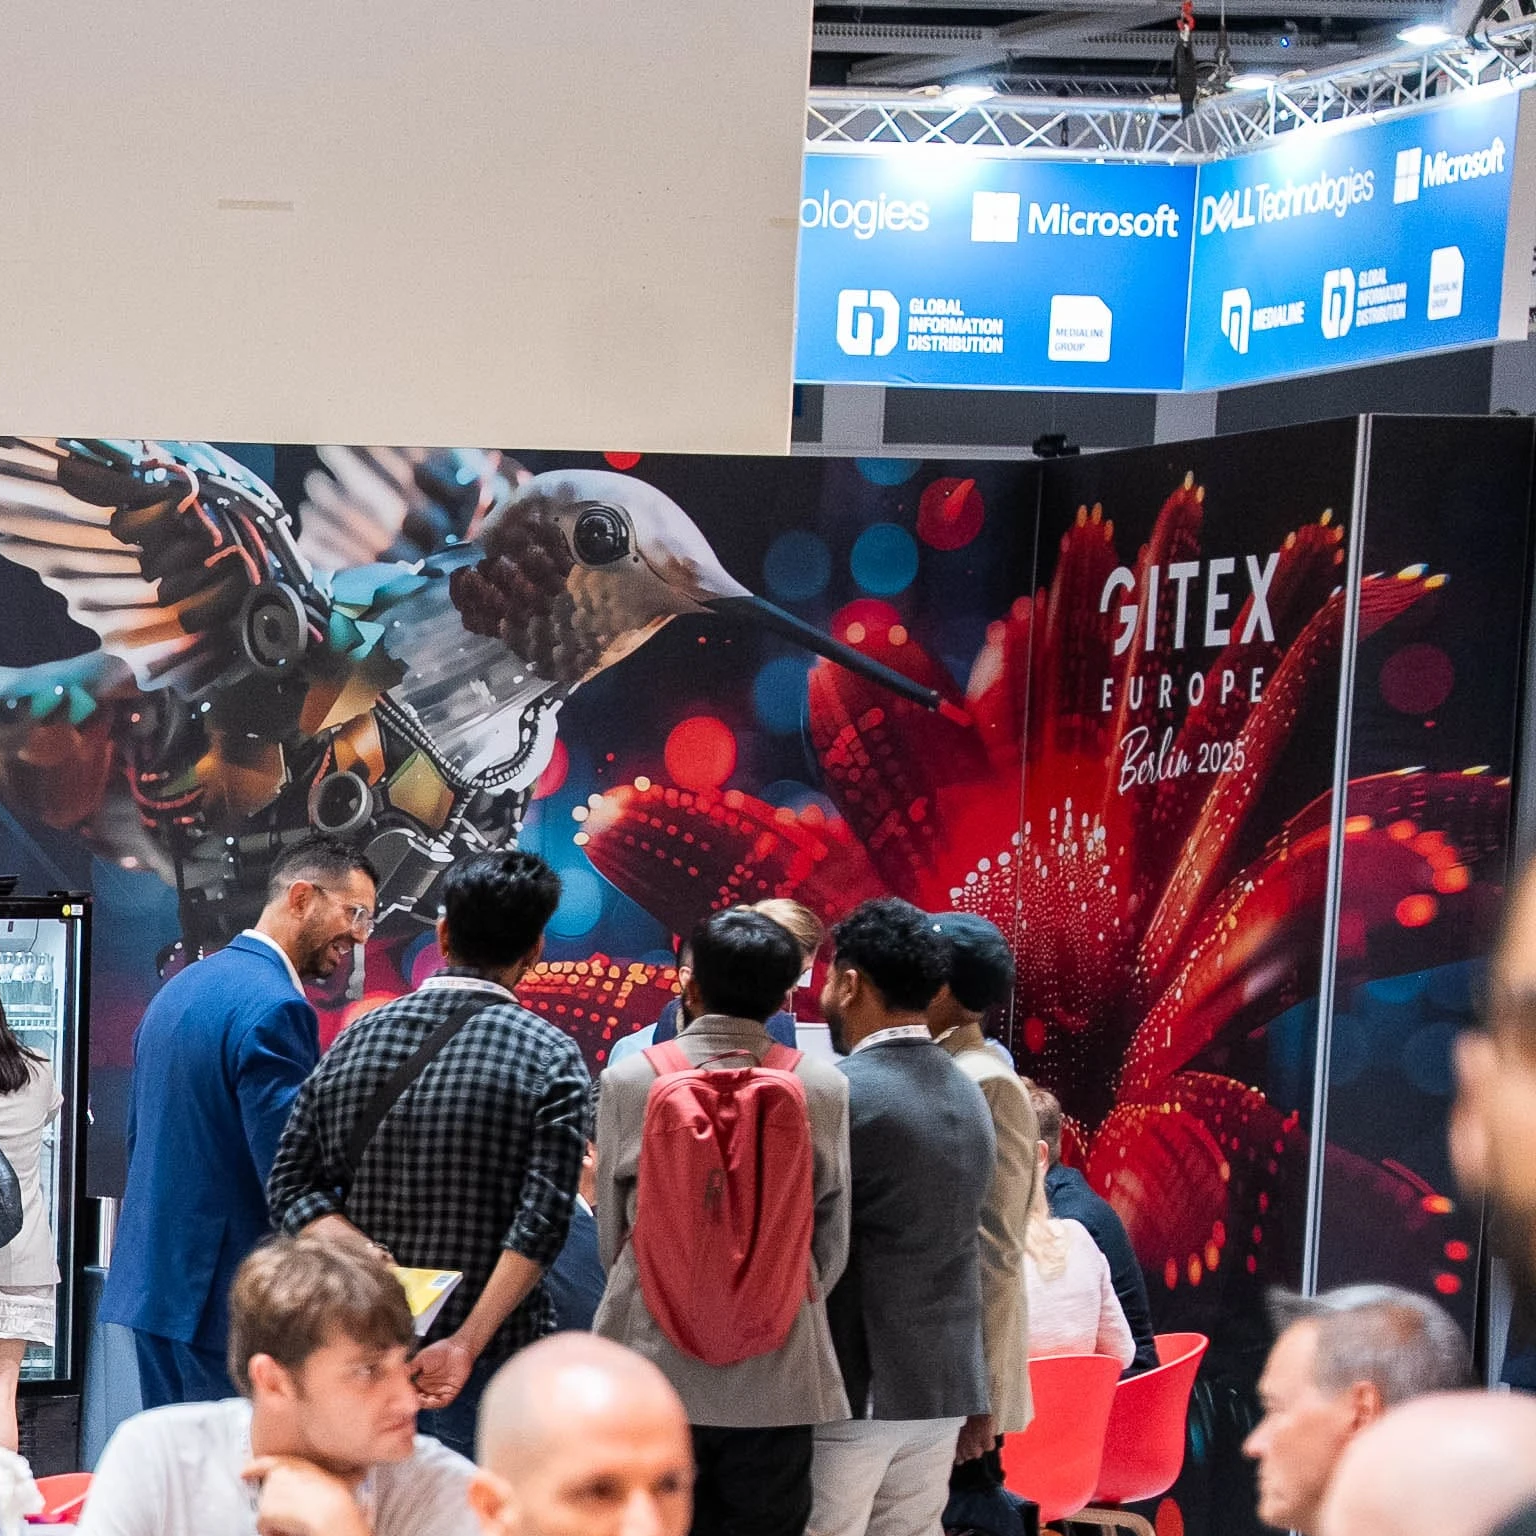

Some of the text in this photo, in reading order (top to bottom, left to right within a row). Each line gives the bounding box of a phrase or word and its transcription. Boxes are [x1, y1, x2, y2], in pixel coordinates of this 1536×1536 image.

[1423, 136, 1506, 188] Microsoft
[800, 190, 929, 240] ologies
[1200, 168, 1375, 235] DELL Technologies
[1028, 203, 1179, 238] Microsoft
[909, 298, 964, 317] GLOBAL
[1252, 301, 1305, 331] MEDIALINE
[908, 316, 1003, 335] INFORMATION
[1055, 328, 1104, 338] MEDIALINE
[907, 334, 1003, 353] DISTRIBUTION
[1054, 342, 1085, 352] GROUP
[1099, 552, 1281, 656] GITEX
[1101, 666, 1265, 712] EUROPE
[1117, 724, 1247, 796] Berlin 2025
